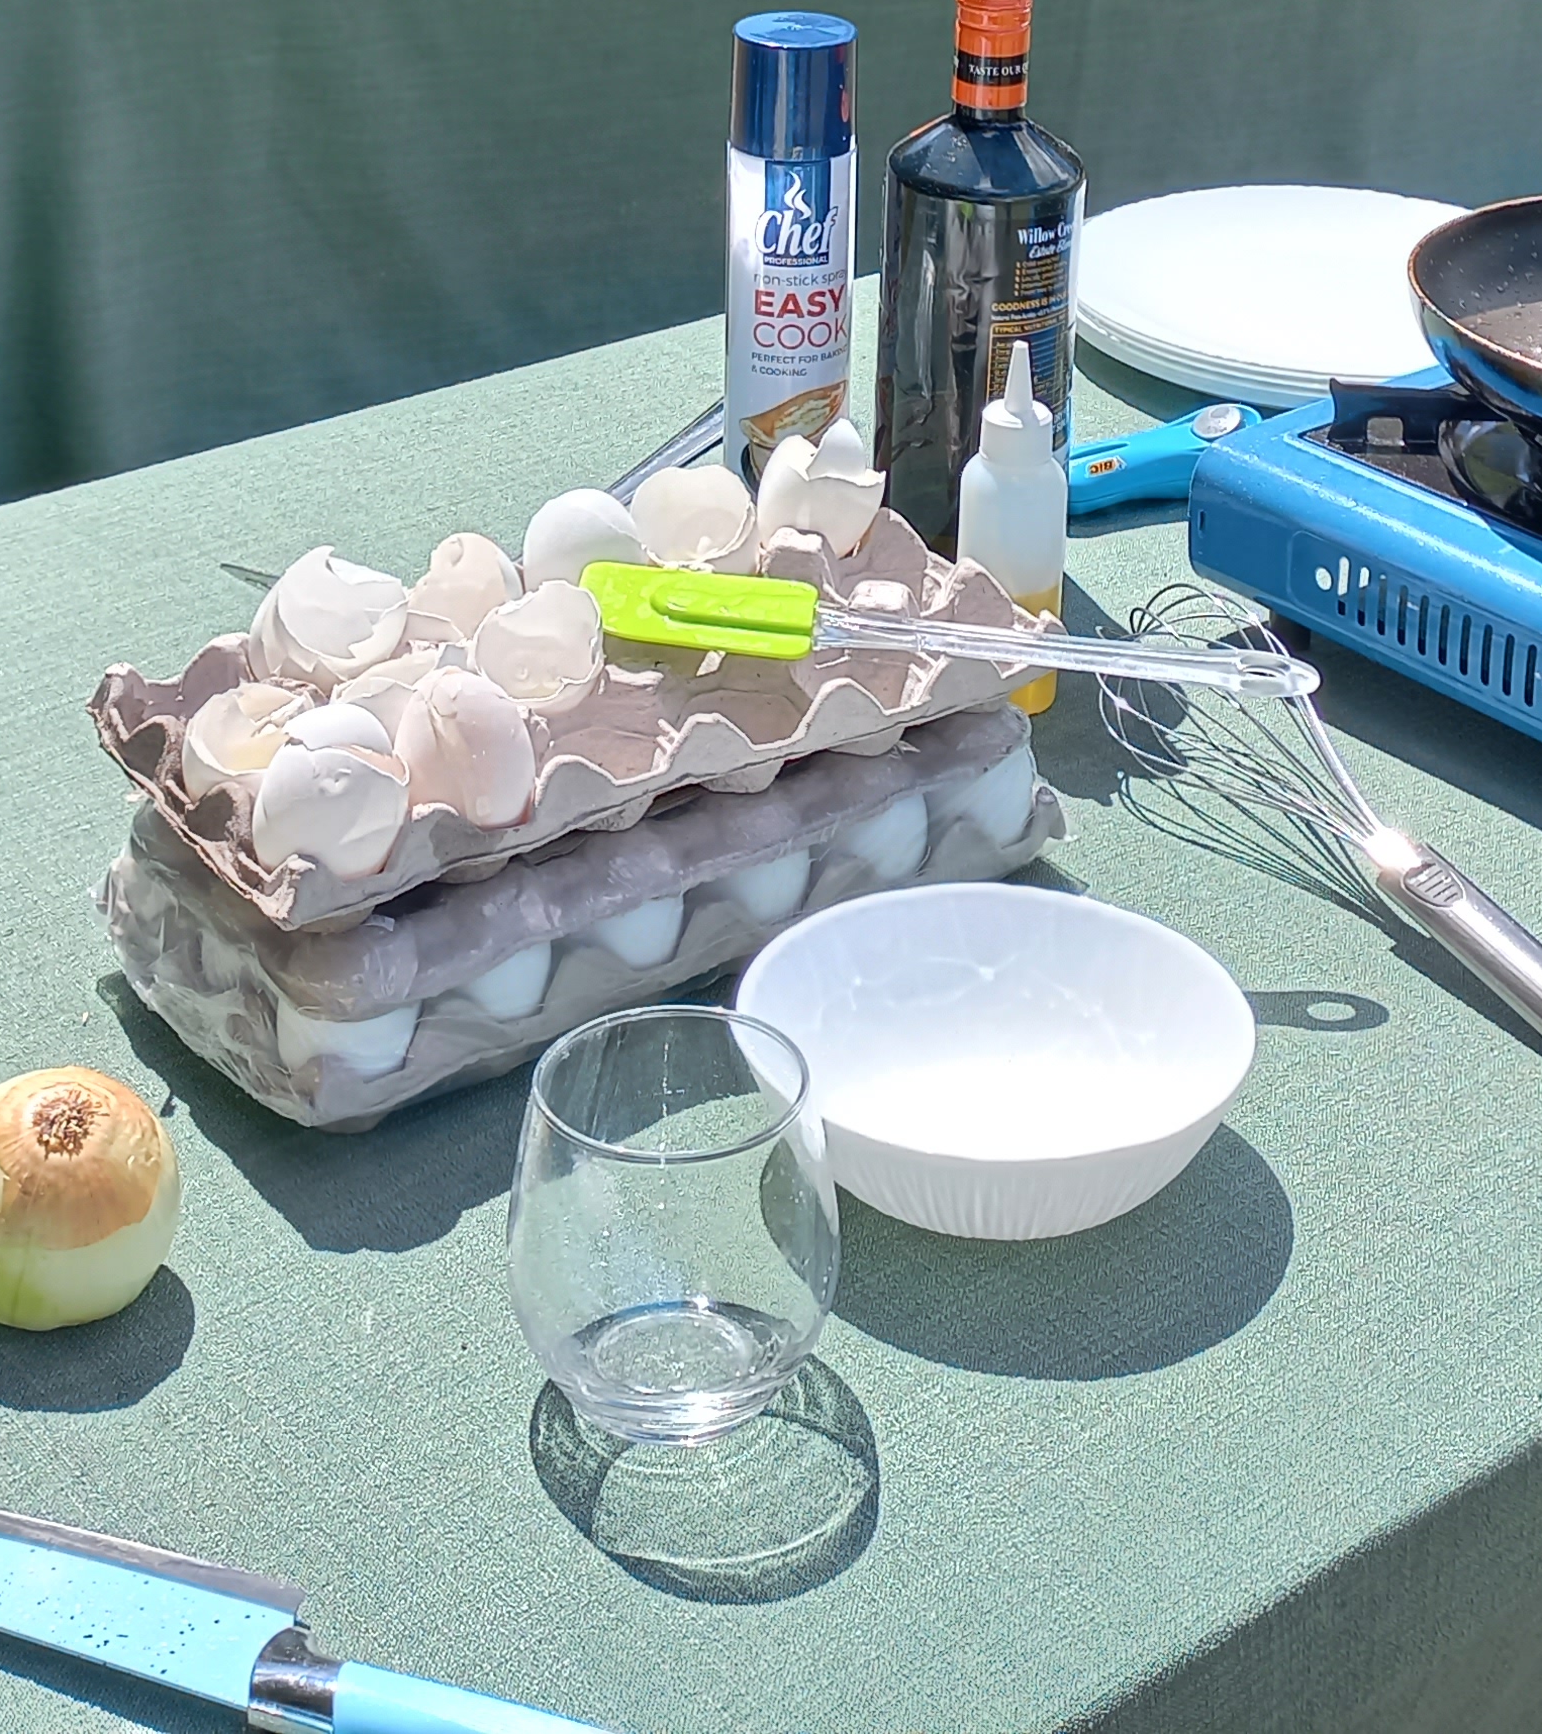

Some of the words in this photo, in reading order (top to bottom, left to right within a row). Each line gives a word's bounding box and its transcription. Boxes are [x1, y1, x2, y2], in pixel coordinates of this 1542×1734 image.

[969, 64, 1000, 76] TASTE
[755, 206, 839, 257] Chef
[1017, 227, 1056, 245] Willow
[763, 255, 829, 266] PROFESSIONAL
[754, 269, 819, 286] non-stick
[754, 284, 845, 319] EASY
[753, 317, 847, 350] COOK
[752, 352, 796, 364] PERFECT
[798, 354, 819, 364] FOR
[759, 366, 808, 377] COOKING
[1088, 459, 1114, 475] BIC
